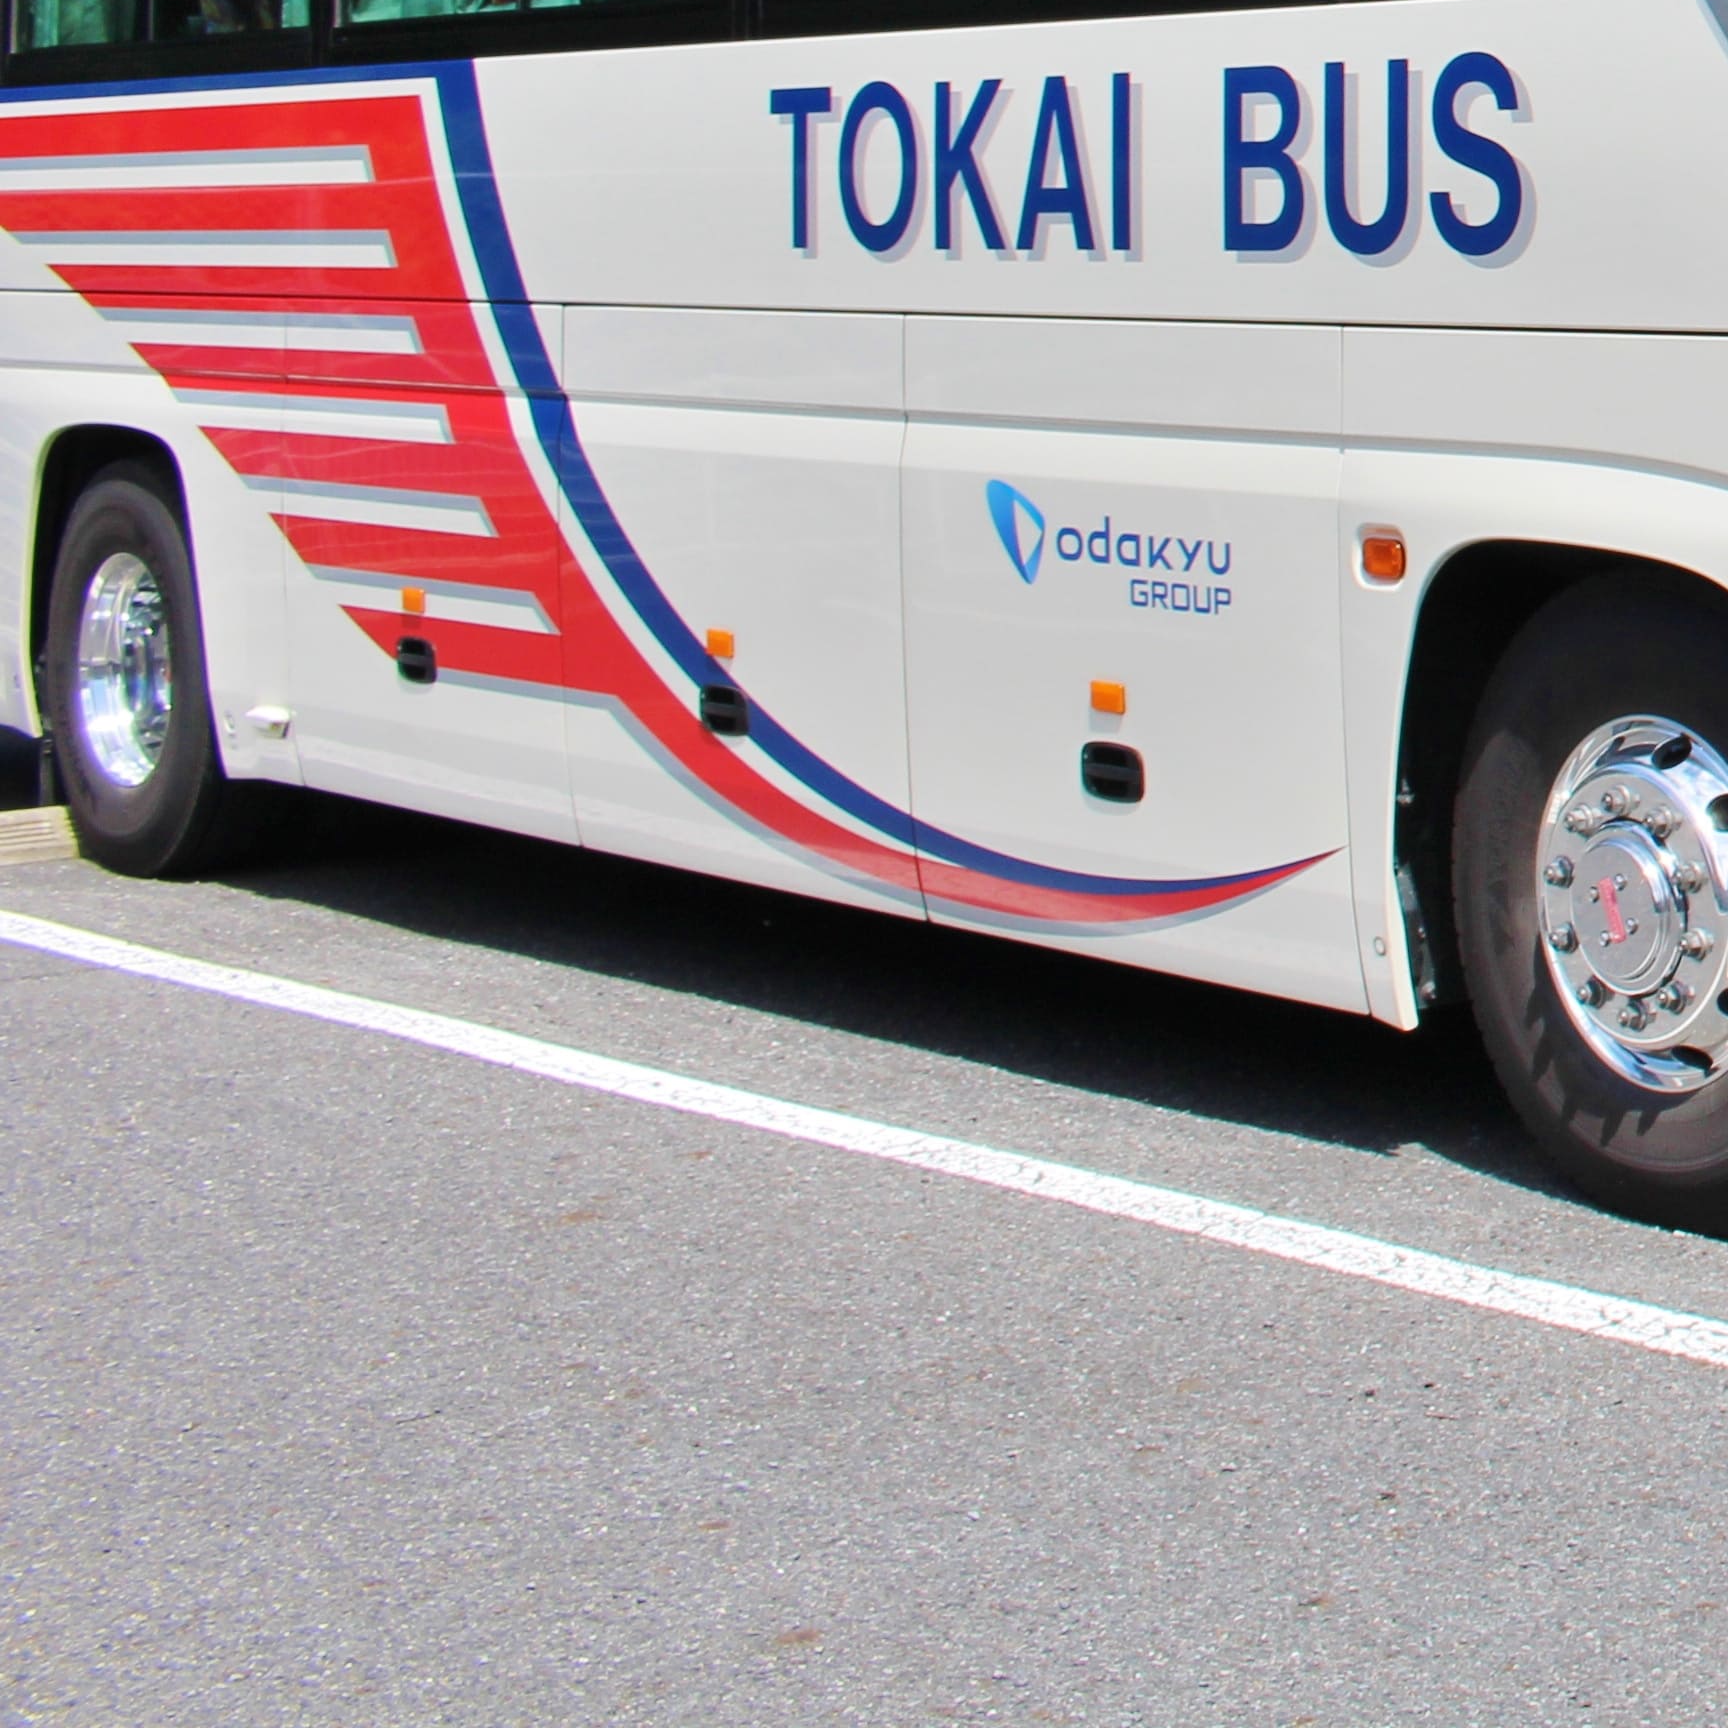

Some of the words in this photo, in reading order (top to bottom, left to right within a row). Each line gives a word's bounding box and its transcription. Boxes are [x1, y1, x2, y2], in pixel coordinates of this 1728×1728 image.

[770, 73, 1142, 261] TOKAI
[1222, 51, 1537, 268] BUS
[1130, 579, 1231, 615] GROUP
